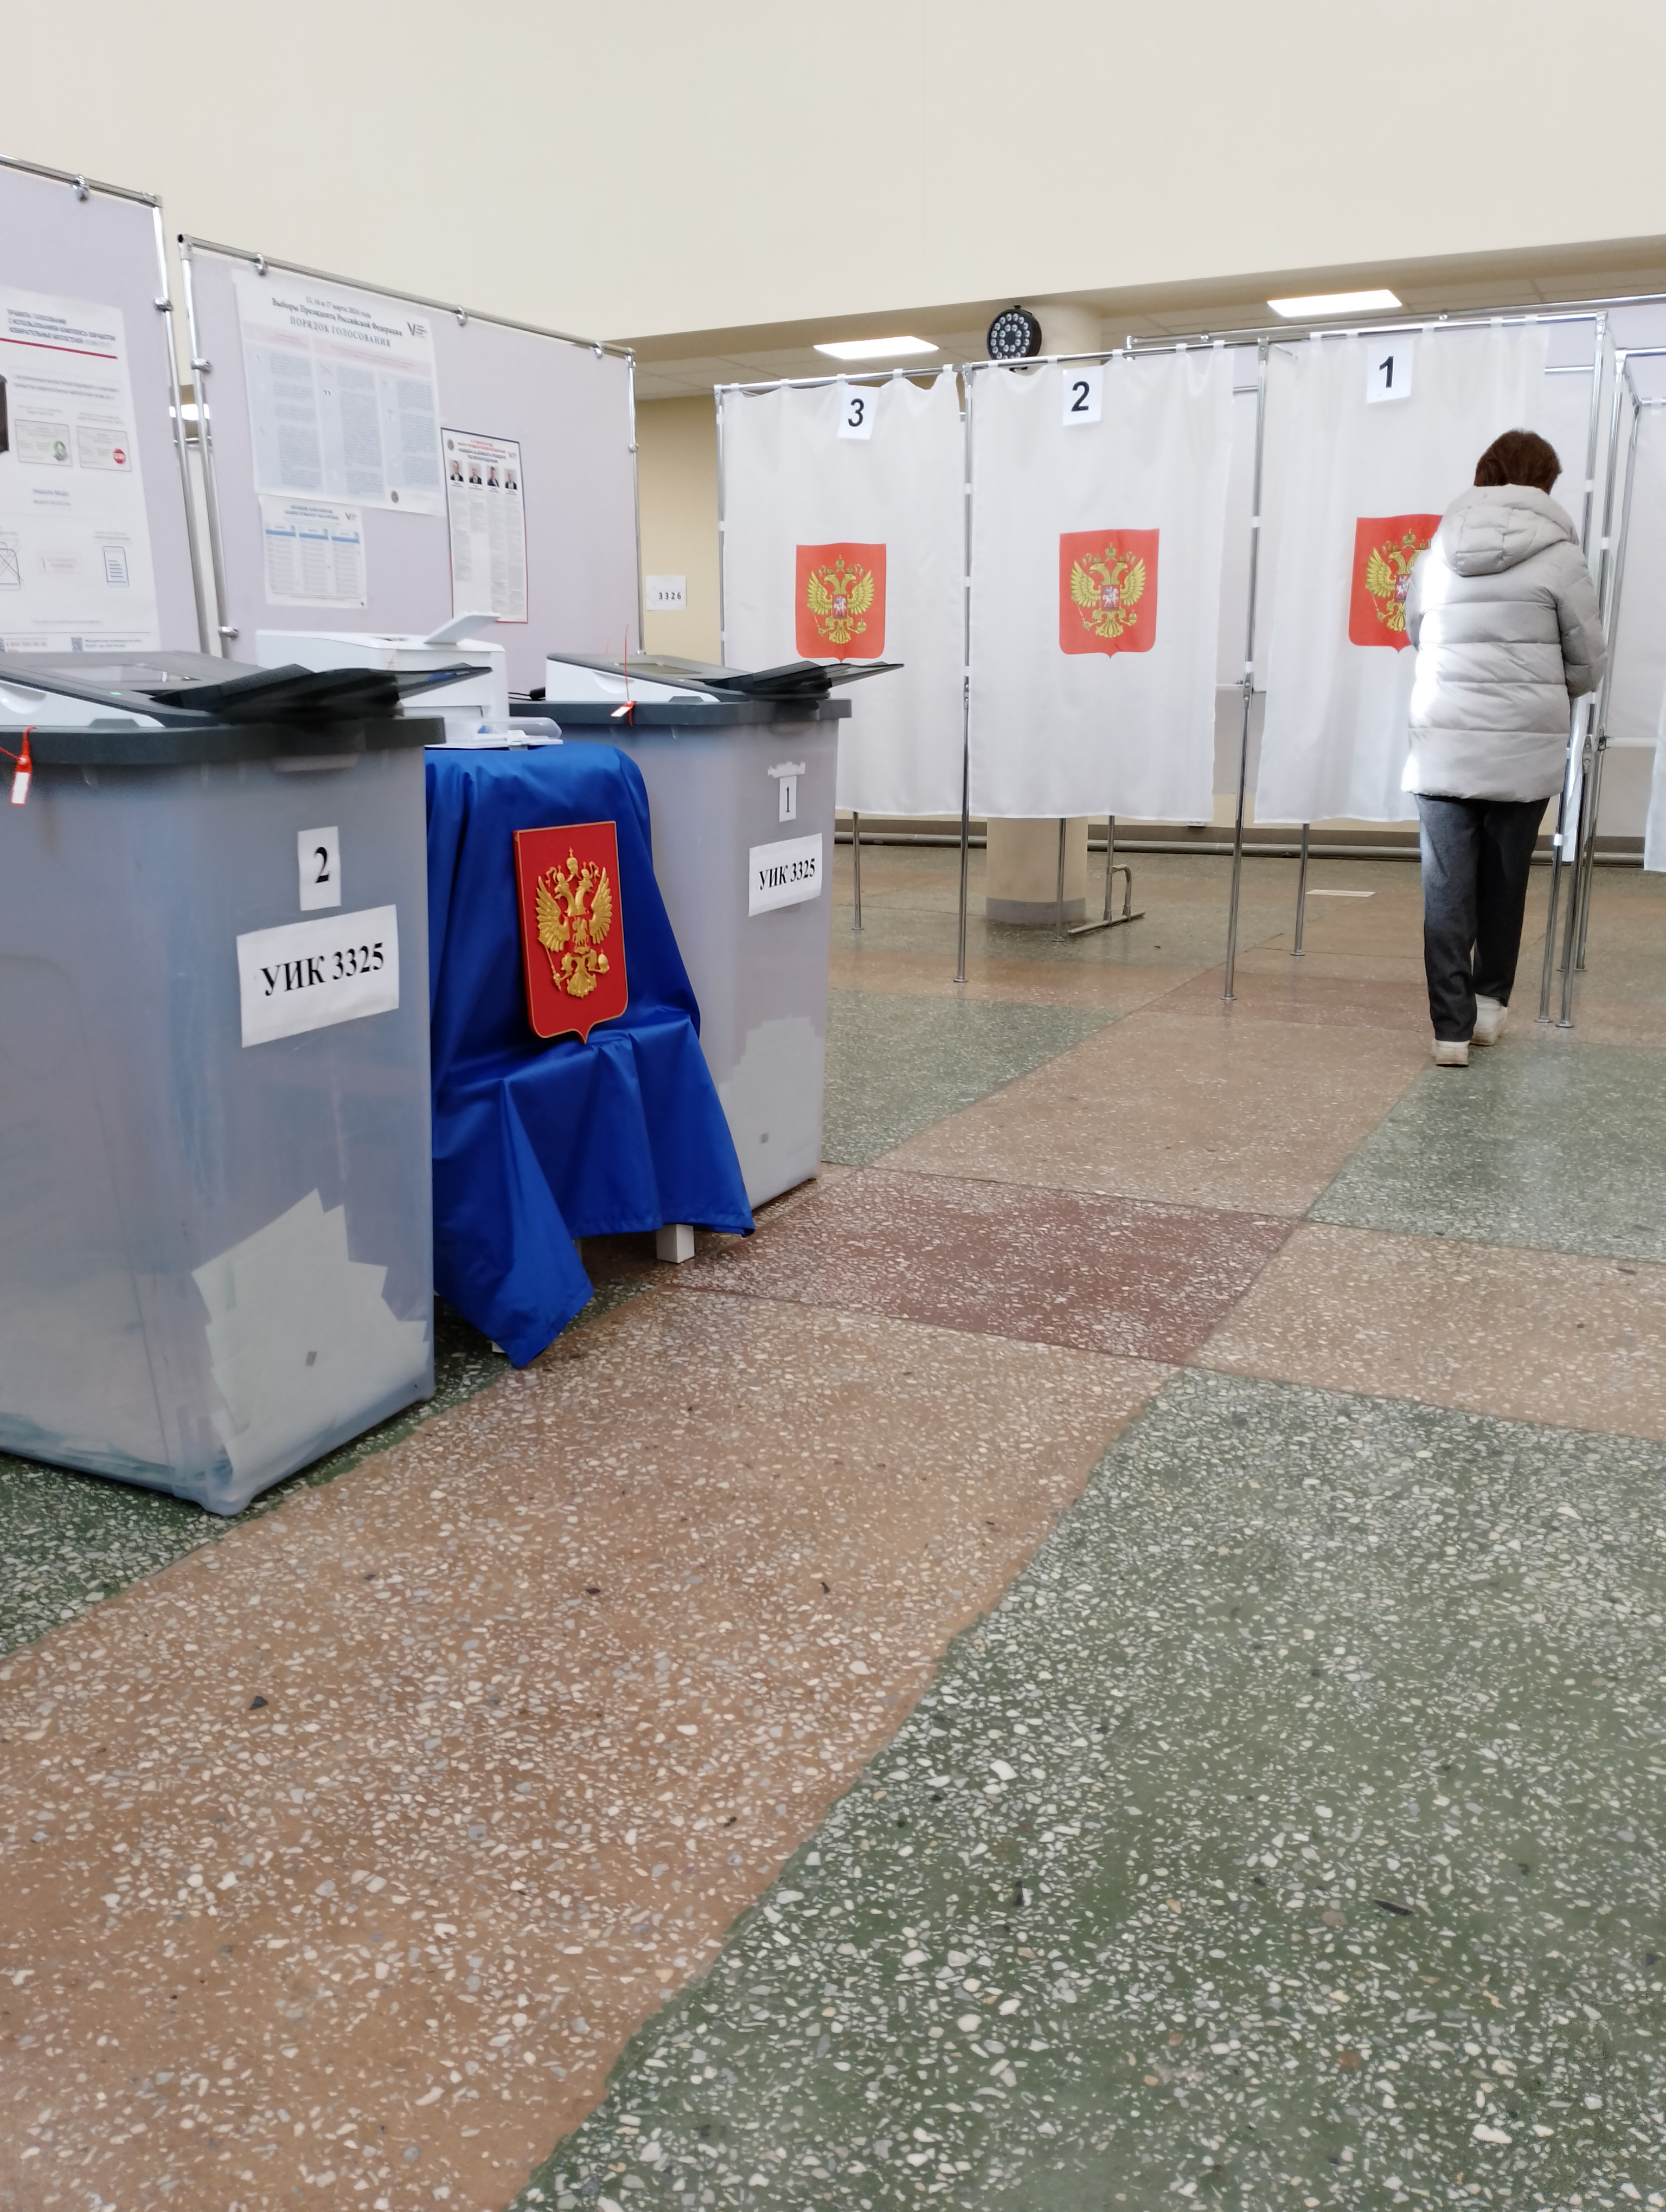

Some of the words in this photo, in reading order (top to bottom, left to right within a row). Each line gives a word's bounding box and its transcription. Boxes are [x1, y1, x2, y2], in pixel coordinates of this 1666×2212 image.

[290, 316, 330, 333] ПОРЯДОК
[332, 325, 391, 347] ГОЛОСОВАНИЯ
[1379, 356, 1394, 388] 1
[1071, 381, 1090, 412] 2
[848, 398, 864, 427] 3
[785, 786, 791, 813] 1
[313, 846, 331, 884] 2
[759, 864, 789, 891] УИК
[790, 858, 816, 883] 3325
[259, 955, 326, 996] УИК
[331, 942, 385, 981] 3325
